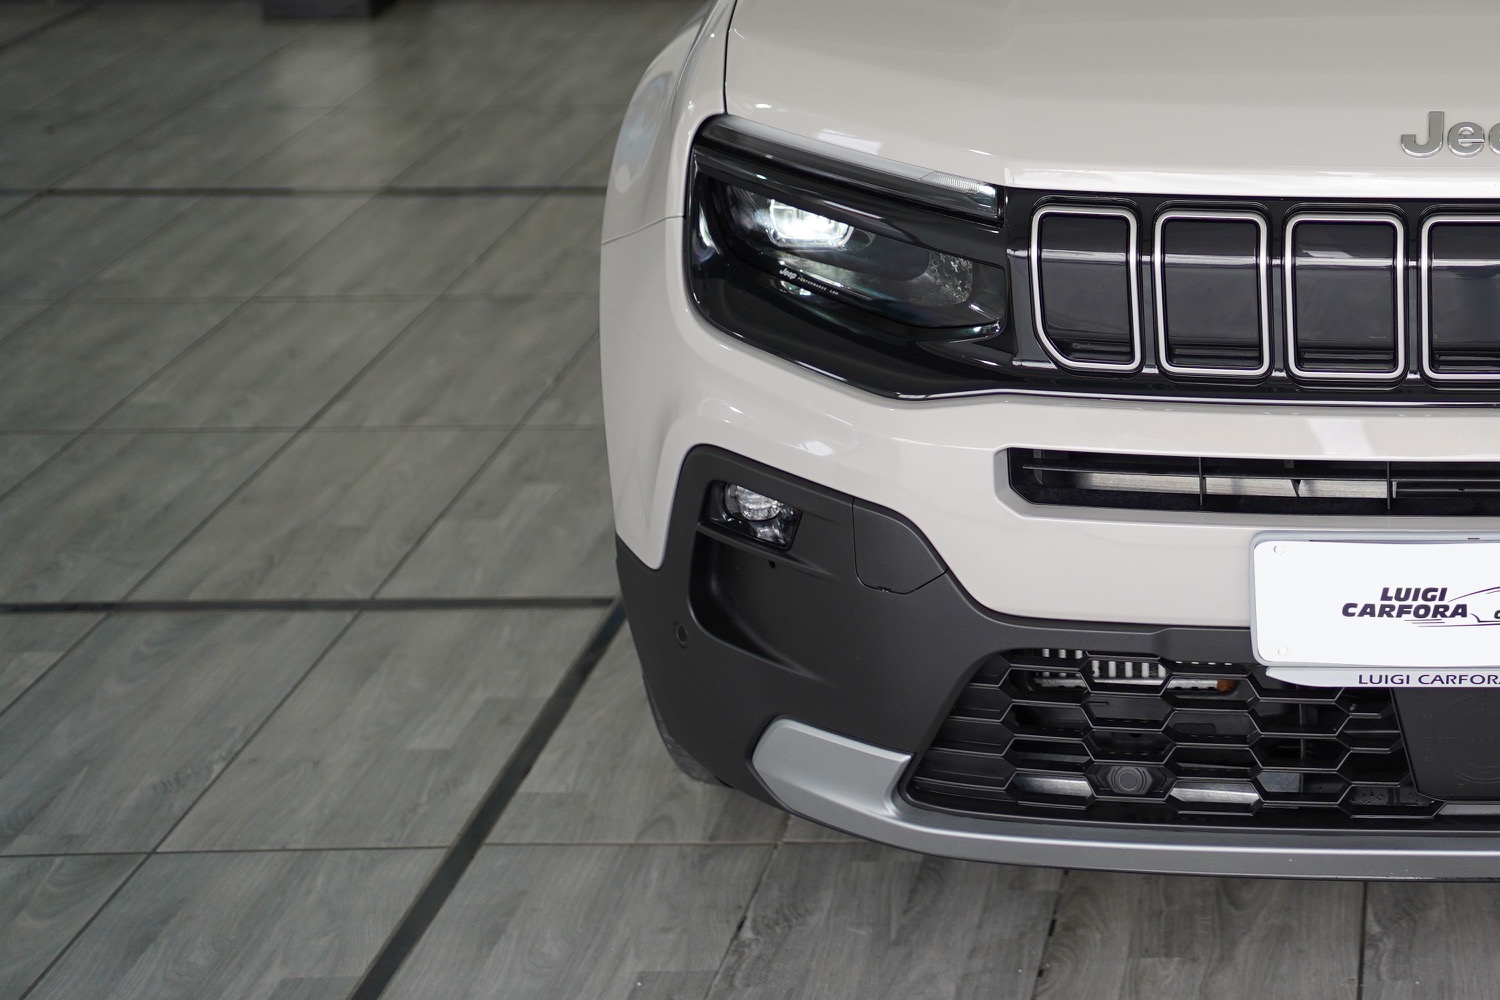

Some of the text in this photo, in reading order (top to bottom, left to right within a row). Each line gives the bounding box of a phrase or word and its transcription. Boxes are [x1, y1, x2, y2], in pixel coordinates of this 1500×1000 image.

[778, 267, 798, 280] Jeep
[1380, 587, 1447, 602] LUIGI
[1341, 602, 1468, 619] CARFORA
[1358, 673, 1411, 686] LUIGI
